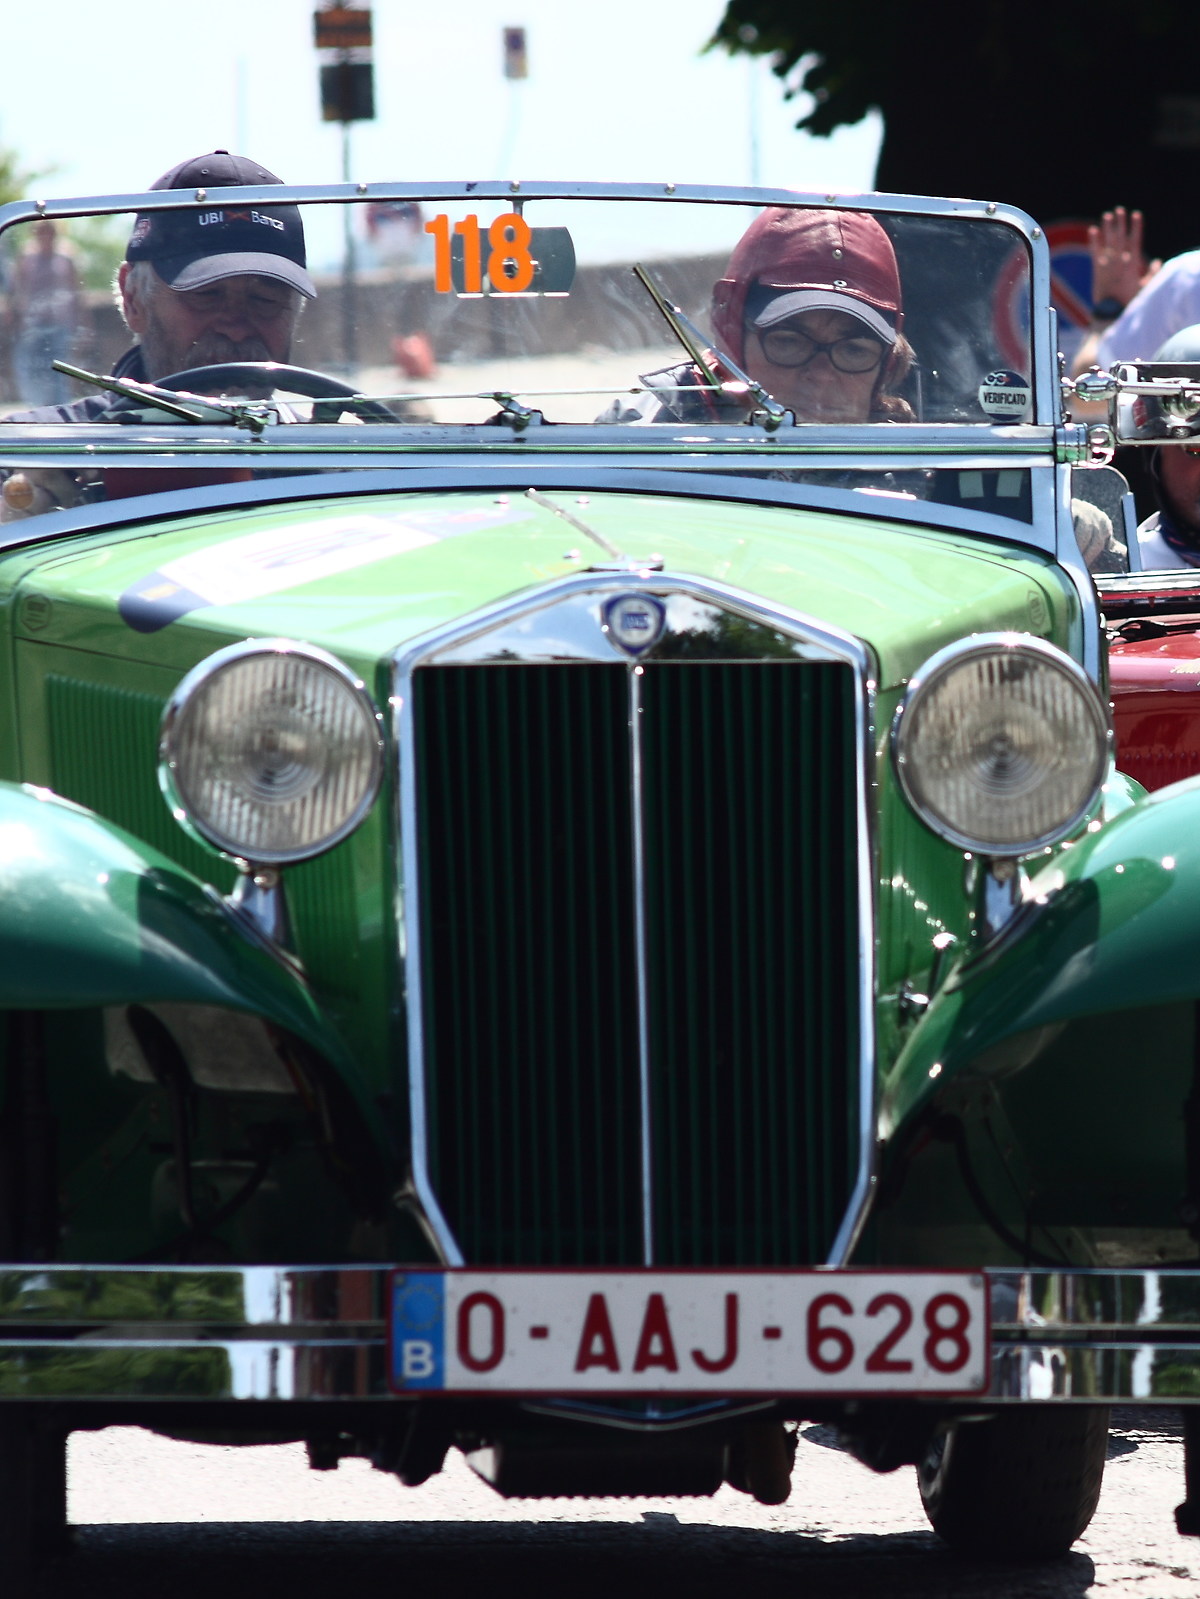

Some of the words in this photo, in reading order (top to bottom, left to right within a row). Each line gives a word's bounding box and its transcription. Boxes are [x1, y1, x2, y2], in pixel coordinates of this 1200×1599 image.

[199, 211, 224, 226] UBI
[251, 210, 285, 231] Banca
[424, 213, 534, 294] 118
[983, 391, 1027, 406] VERIFICATO
[402, 1341, 434, 1379] B
